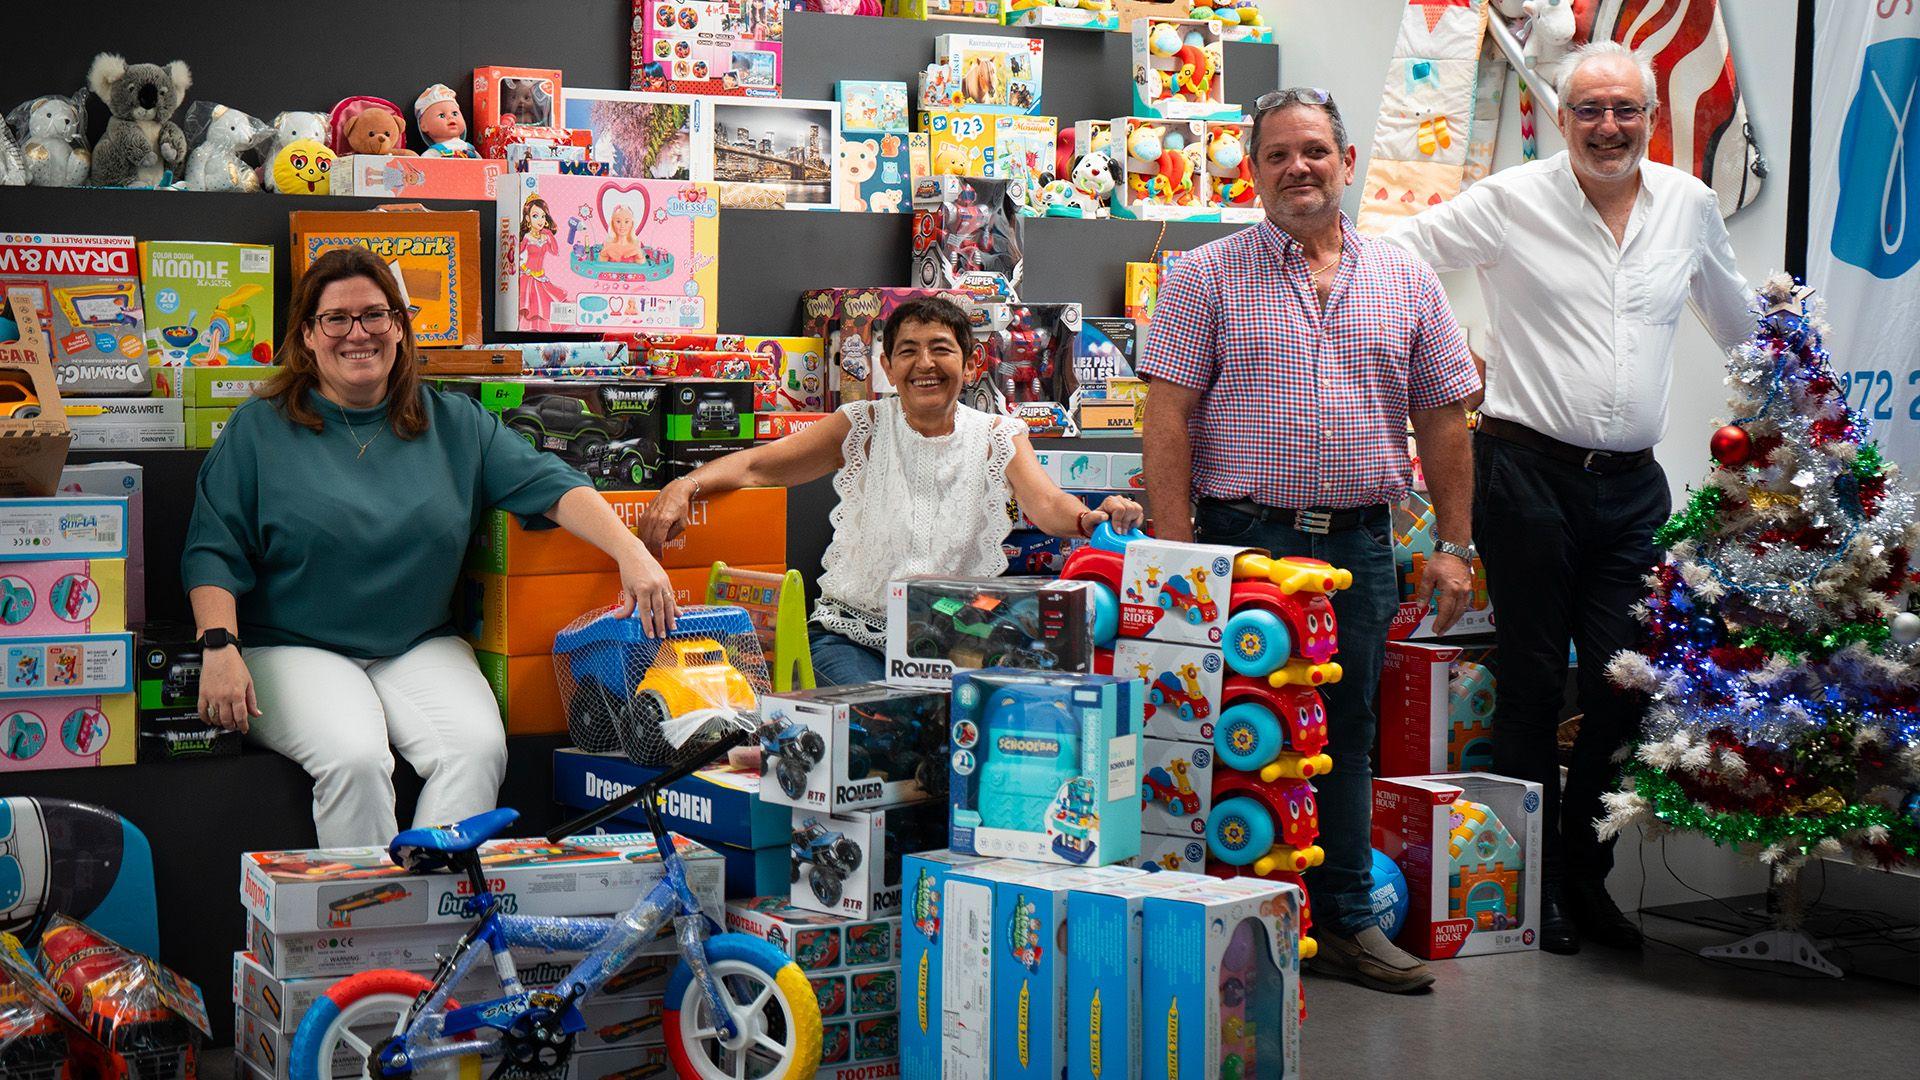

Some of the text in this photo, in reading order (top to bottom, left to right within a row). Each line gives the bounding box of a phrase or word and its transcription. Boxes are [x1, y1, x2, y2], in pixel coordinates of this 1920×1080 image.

[672, 201, 713, 212] DRESSER
[51, 236, 131, 246] MAGNETISM PALETTE
[356, 237, 451, 256] Art Park
[152, 251, 194, 260] COLOR DOUGH
[500, 217, 509, 292] DRESSER
[151, 259, 229, 280] NOODLE
[966, 276, 995, 286] SUPER
[159, 292, 177, 303] 20
[1094, 356, 1114, 368] PAS
[55, 363, 145, 385] DRAWING!
[495, 389, 510, 399] 6+
[616, 391, 645, 401] DARK
[612, 400, 649, 410] RALLY
[1021, 407, 1052, 417] SUPER
[1107, 418, 1133, 426] KAPLA
[1123, 606, 1137, 614] BABY
[1123, 612, 1155, 625] RIDER
[1392, 615, 1416, 625] OUSE
[178, 731, 206, 741] DARK
[173, 740, 210, 751] RALLY
[807, 789, 826, 803] RTR
[836, 782, 884, 805] ROVER
[1375, 790, 1401, 802] ACTIVITY
[1375, 798, 1397, 810] HOUSE
[843, 897, 863, 910] RTR
[726, 911, 764, 936] FOOTBALL
[1435, 923, 1468, 935] ACTIVITY
[1435, 932, 1462, 943] HOUSE
